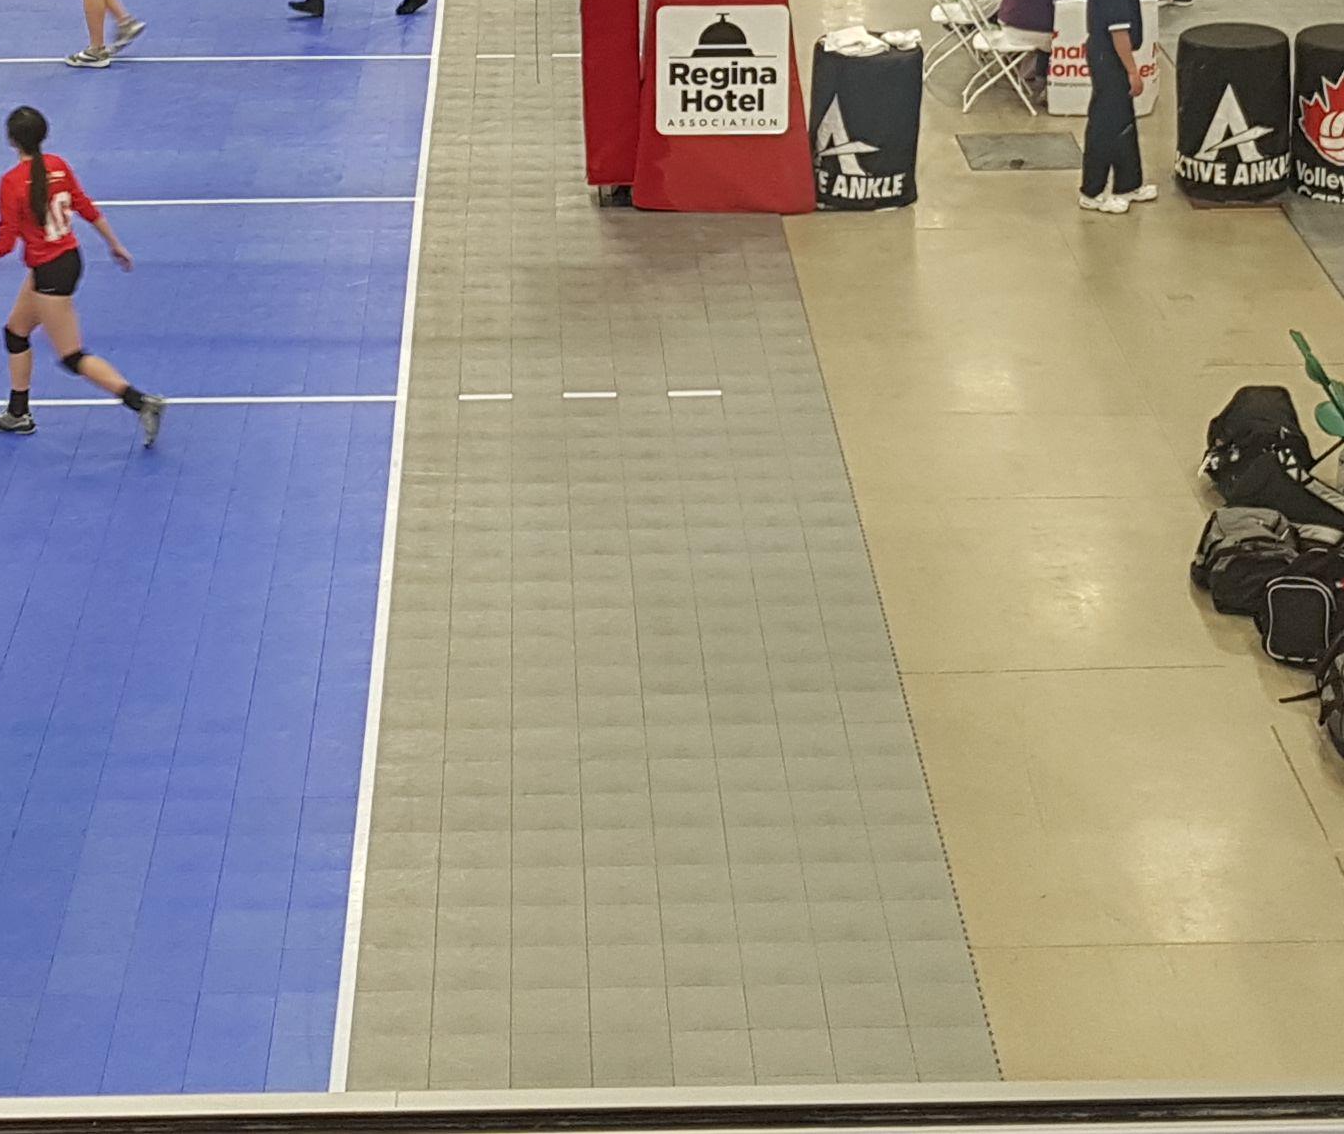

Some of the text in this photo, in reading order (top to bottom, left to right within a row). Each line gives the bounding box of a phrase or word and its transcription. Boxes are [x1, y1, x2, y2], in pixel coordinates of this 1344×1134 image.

[669, 61, 777, 90] Regina
[681, 88, 765, 112] Hotel
[667, 118, 778, 128] ASSOCIATION
[832, 173, 906, 200] ANKLE
